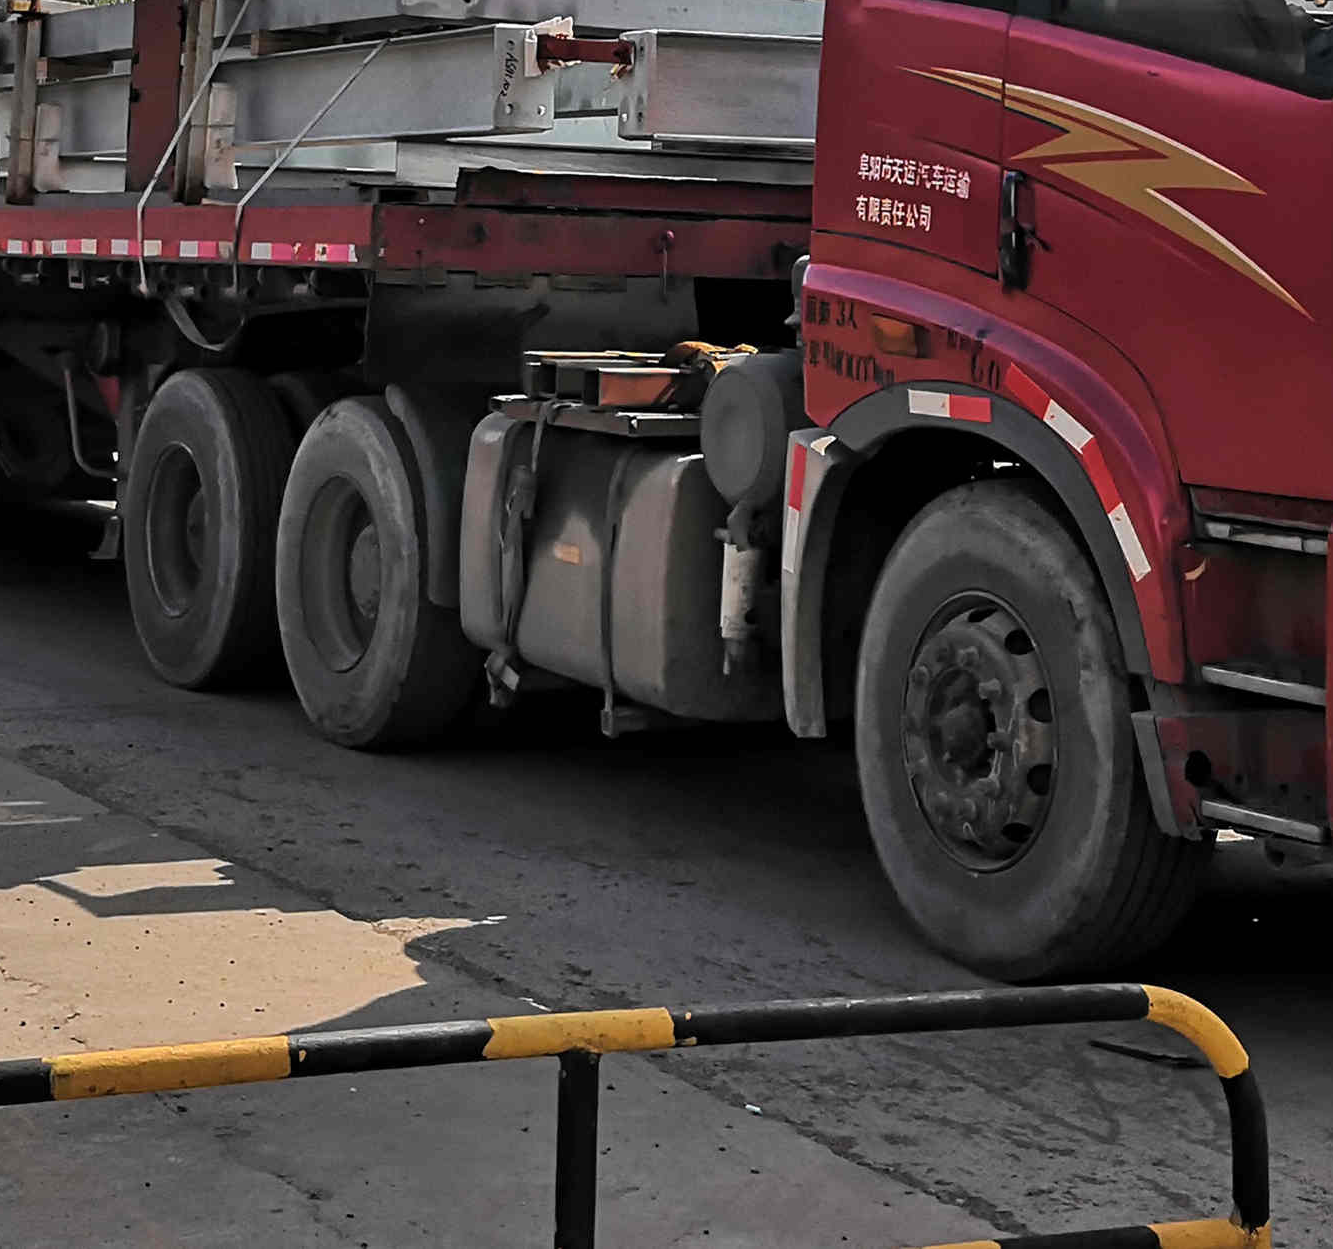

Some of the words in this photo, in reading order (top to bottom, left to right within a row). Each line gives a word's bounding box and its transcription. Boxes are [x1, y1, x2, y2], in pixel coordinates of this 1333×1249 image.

[856, 194, 932, 231] 有限责任公司
